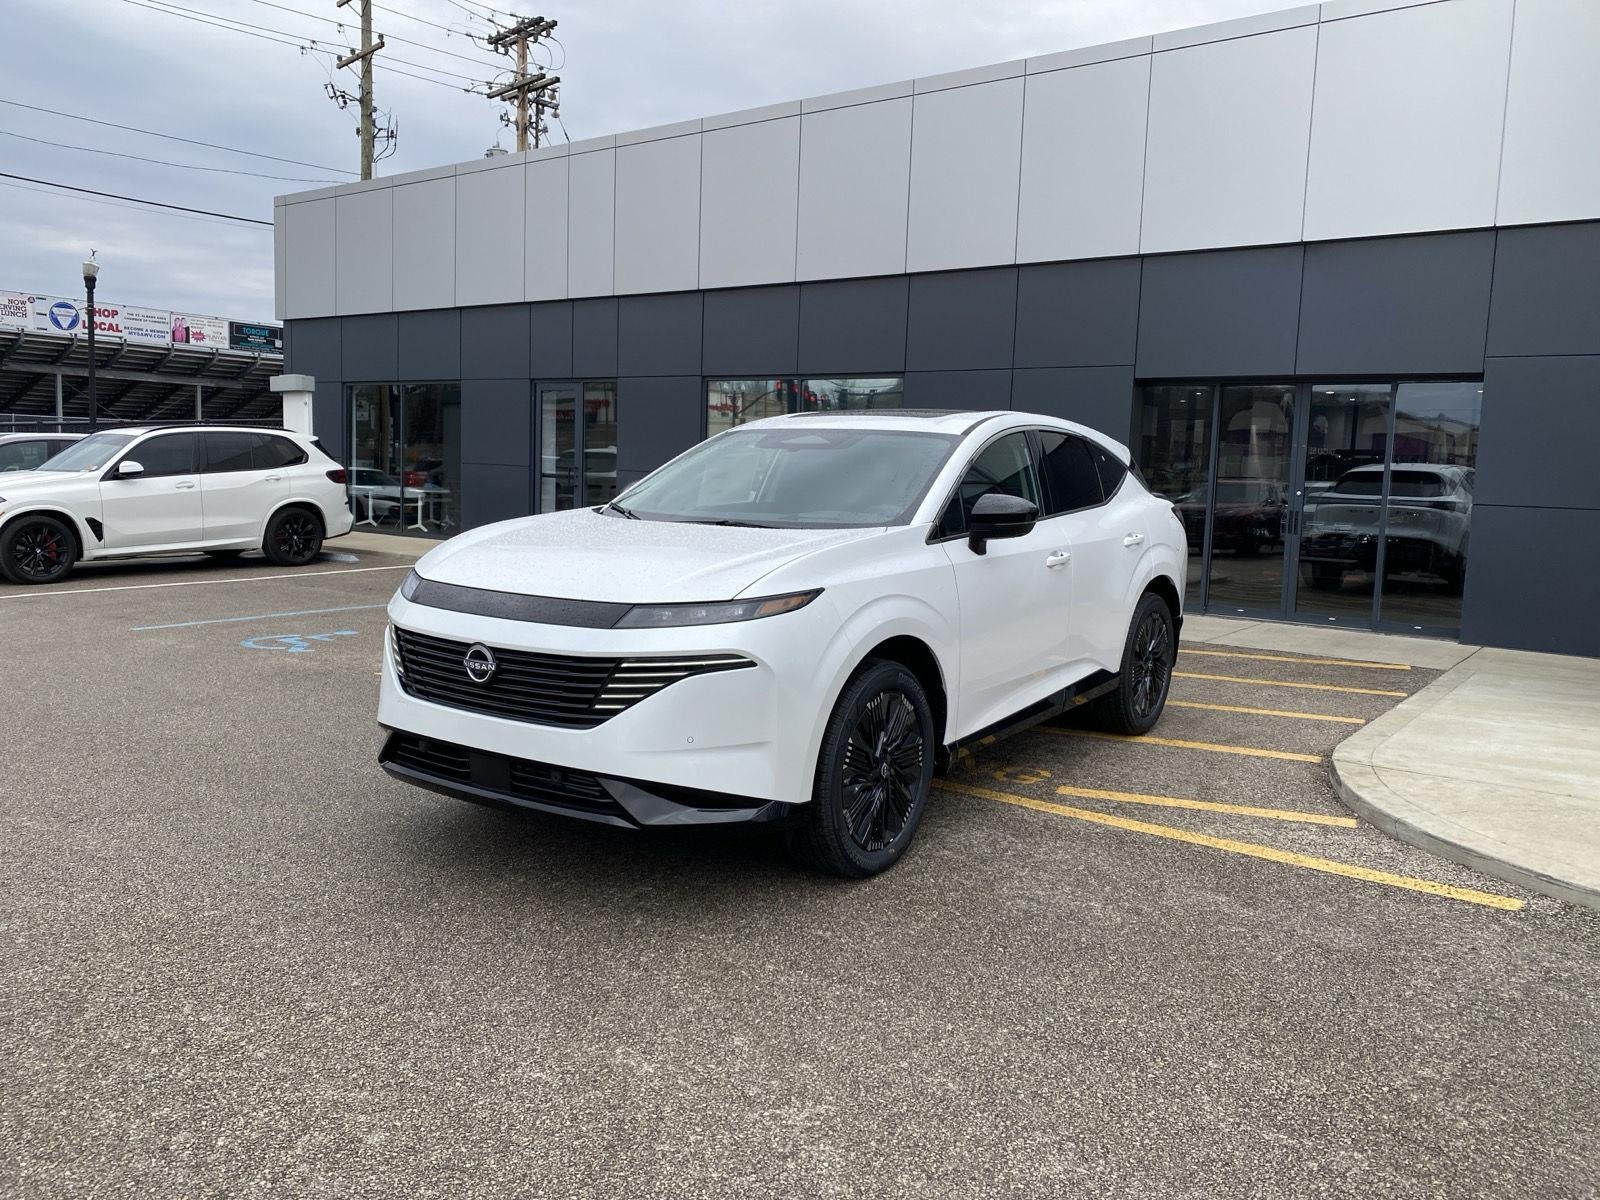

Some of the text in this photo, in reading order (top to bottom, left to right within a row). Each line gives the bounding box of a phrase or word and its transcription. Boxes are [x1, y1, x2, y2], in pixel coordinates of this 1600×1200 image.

[8, 298, 27, 306] NOW
[1, 310, 27, 318] LUNCH
[86, 307, 118, 318] HOP
[242, 327, 269, 336] TORQUE
[464, 660, 495, 670] NISSAN
